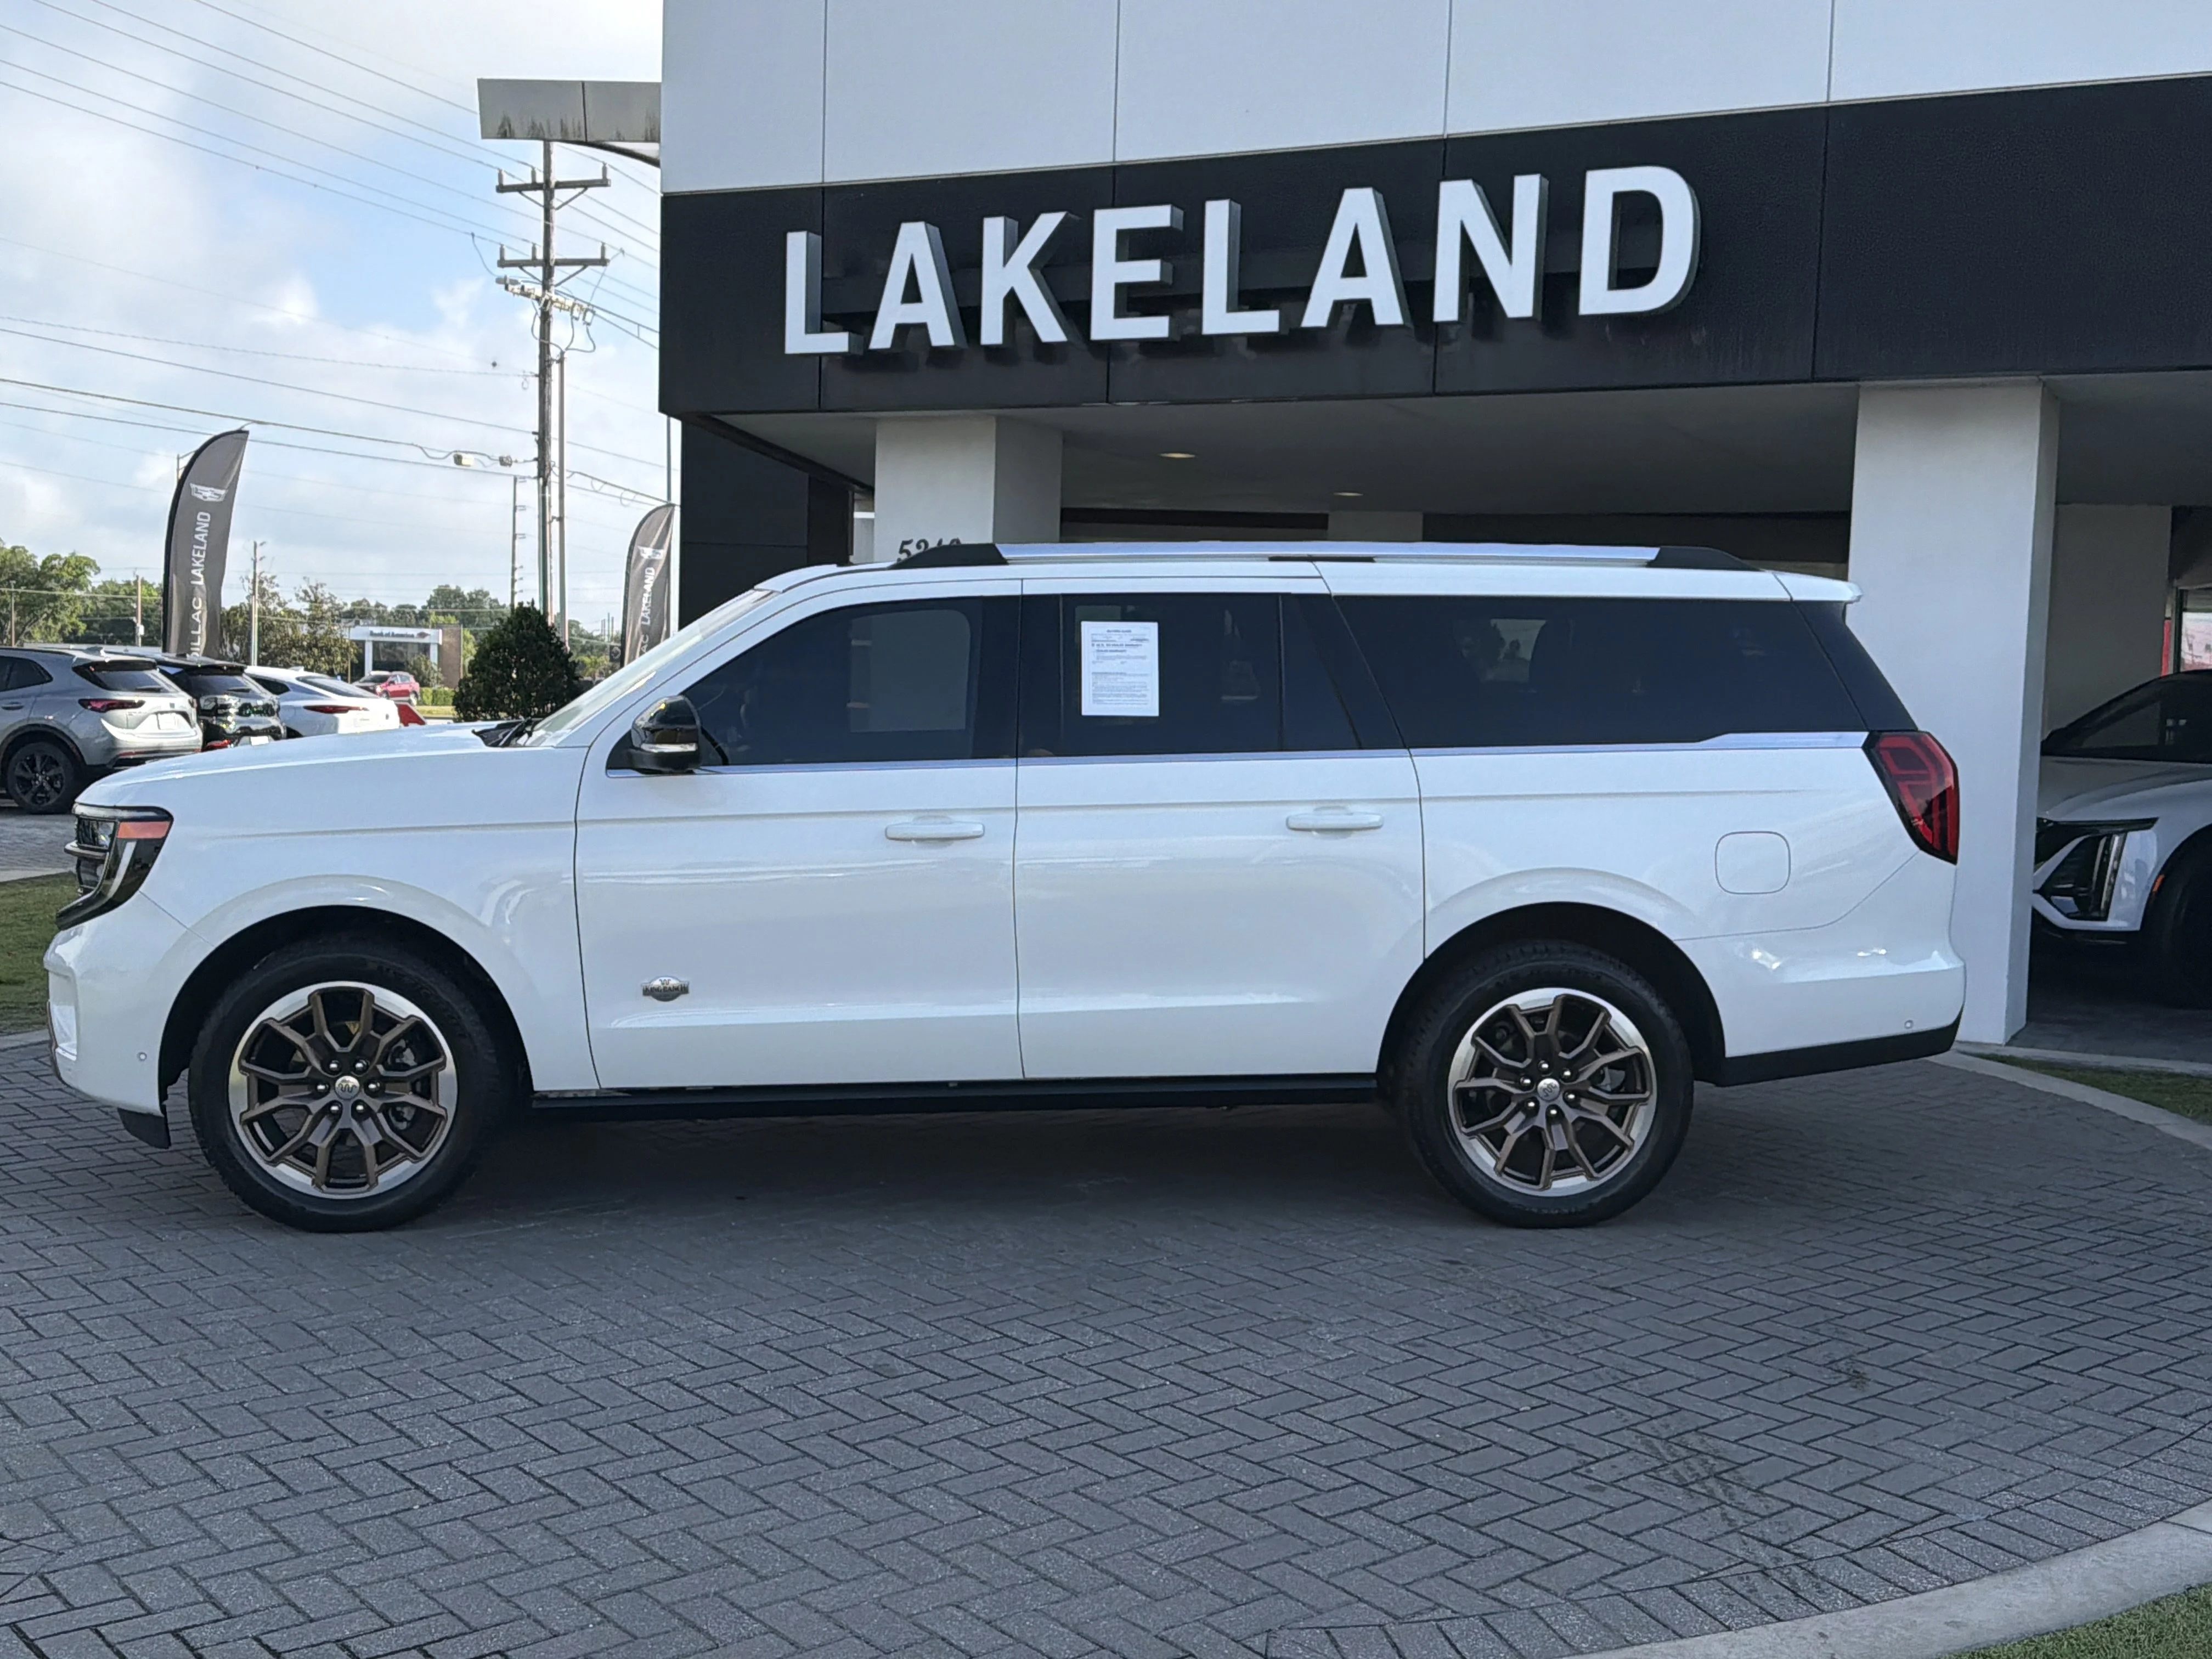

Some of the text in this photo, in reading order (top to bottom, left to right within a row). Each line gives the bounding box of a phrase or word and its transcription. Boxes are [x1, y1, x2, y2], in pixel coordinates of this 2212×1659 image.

[785, 165, 1699, 354] LAKELAND
[190, 511, 211, 585] LAKELAND
[641, 567, 655, 625] LAKELAND
